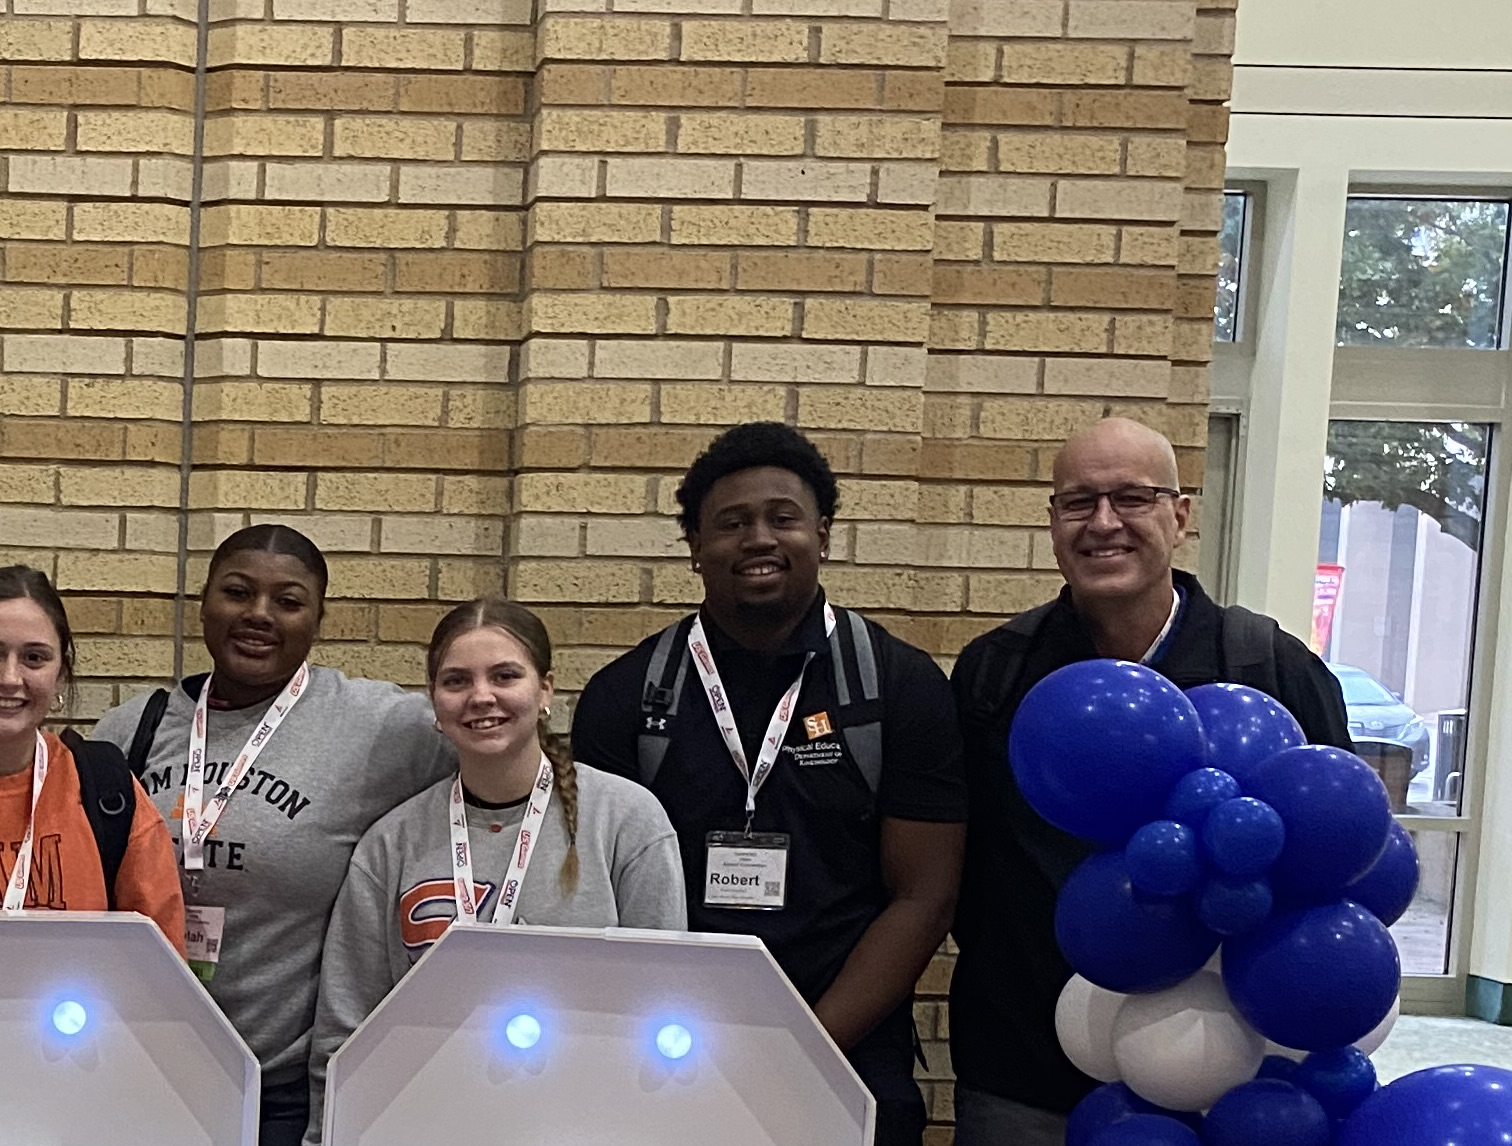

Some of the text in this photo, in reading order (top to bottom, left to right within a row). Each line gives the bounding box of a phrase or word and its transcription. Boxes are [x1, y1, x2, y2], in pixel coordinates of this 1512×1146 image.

[711, 684, 727, 712] OPEN
[252, 721, 273, 747] OPEN
[540, 766, 552, 794] OPEN
[456, 842, 466, 868] OPEN
[710, 873, 760, 886] Robert
[503, 879, 518, 908] OPEN
